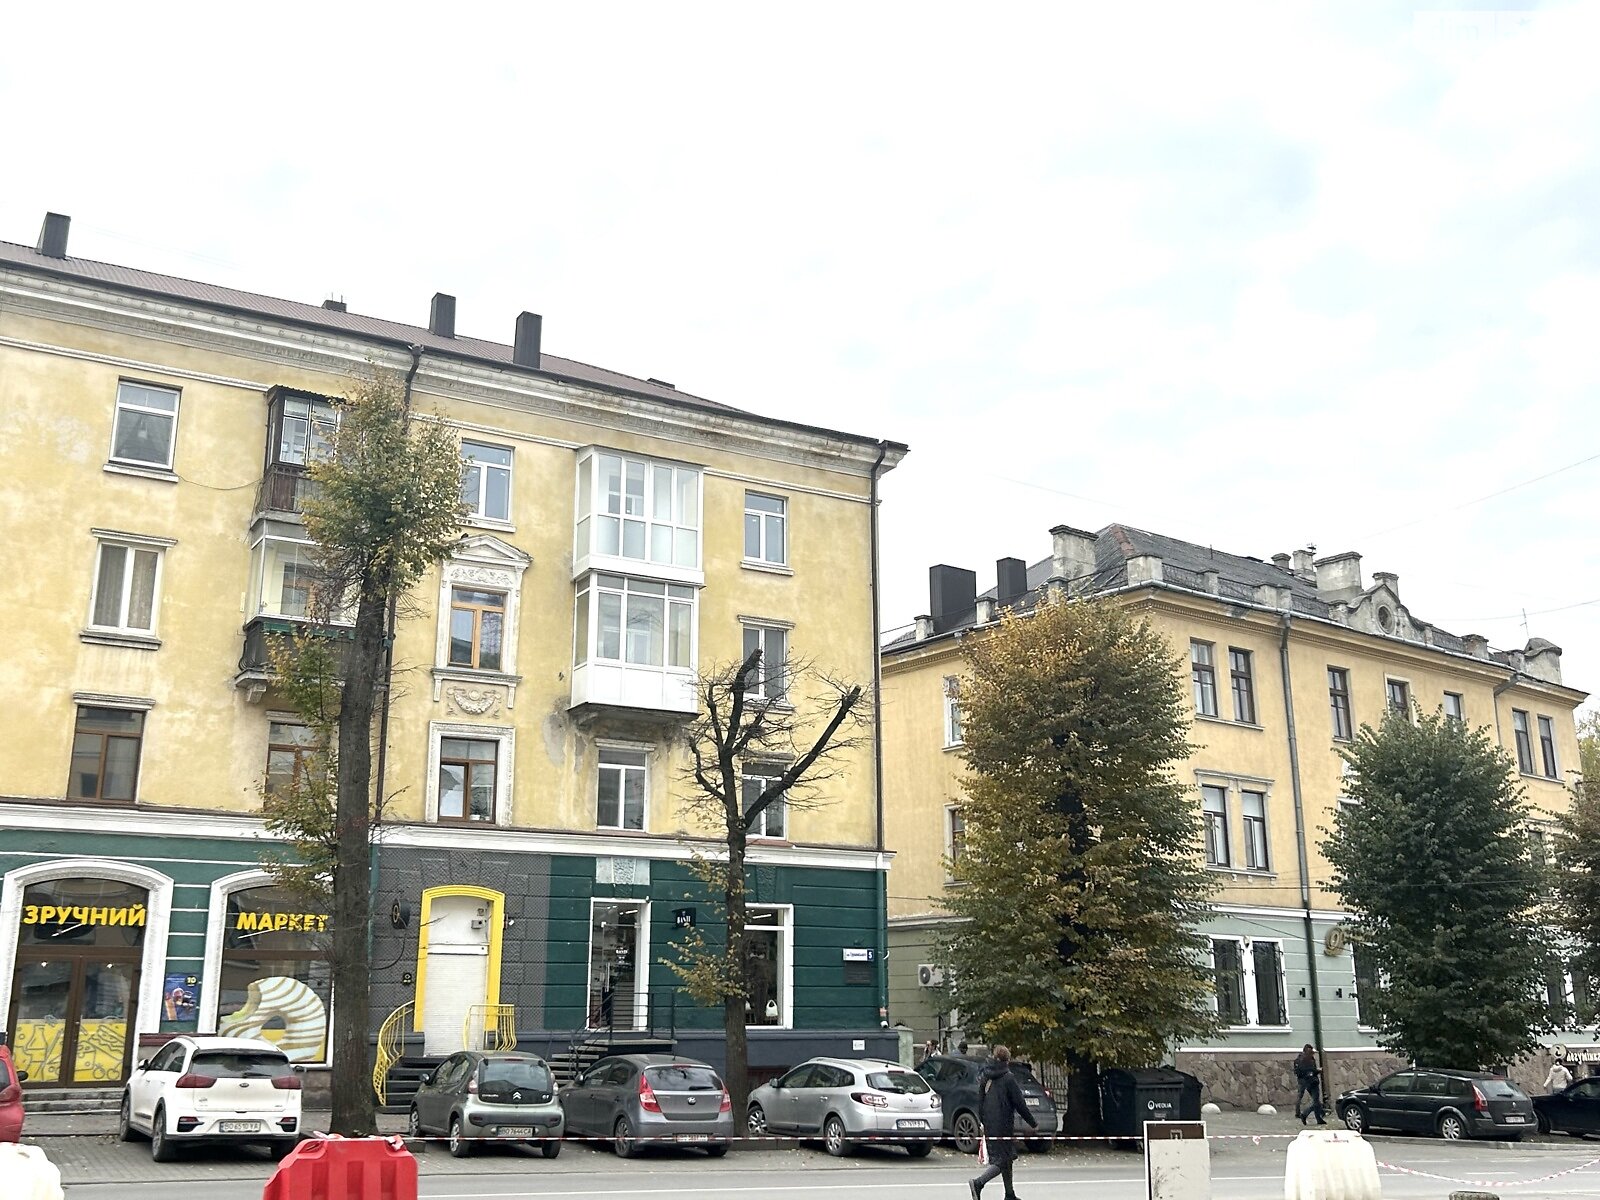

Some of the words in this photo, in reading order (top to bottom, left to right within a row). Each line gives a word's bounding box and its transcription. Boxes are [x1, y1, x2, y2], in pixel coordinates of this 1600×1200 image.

[23, 903, 146, 927] ЗРУЧНИЙ
[236, 912, 329, 933] МАРКЕТ
[868, 951, 873, 959] 5
[187, 976, 197, 984] 10
